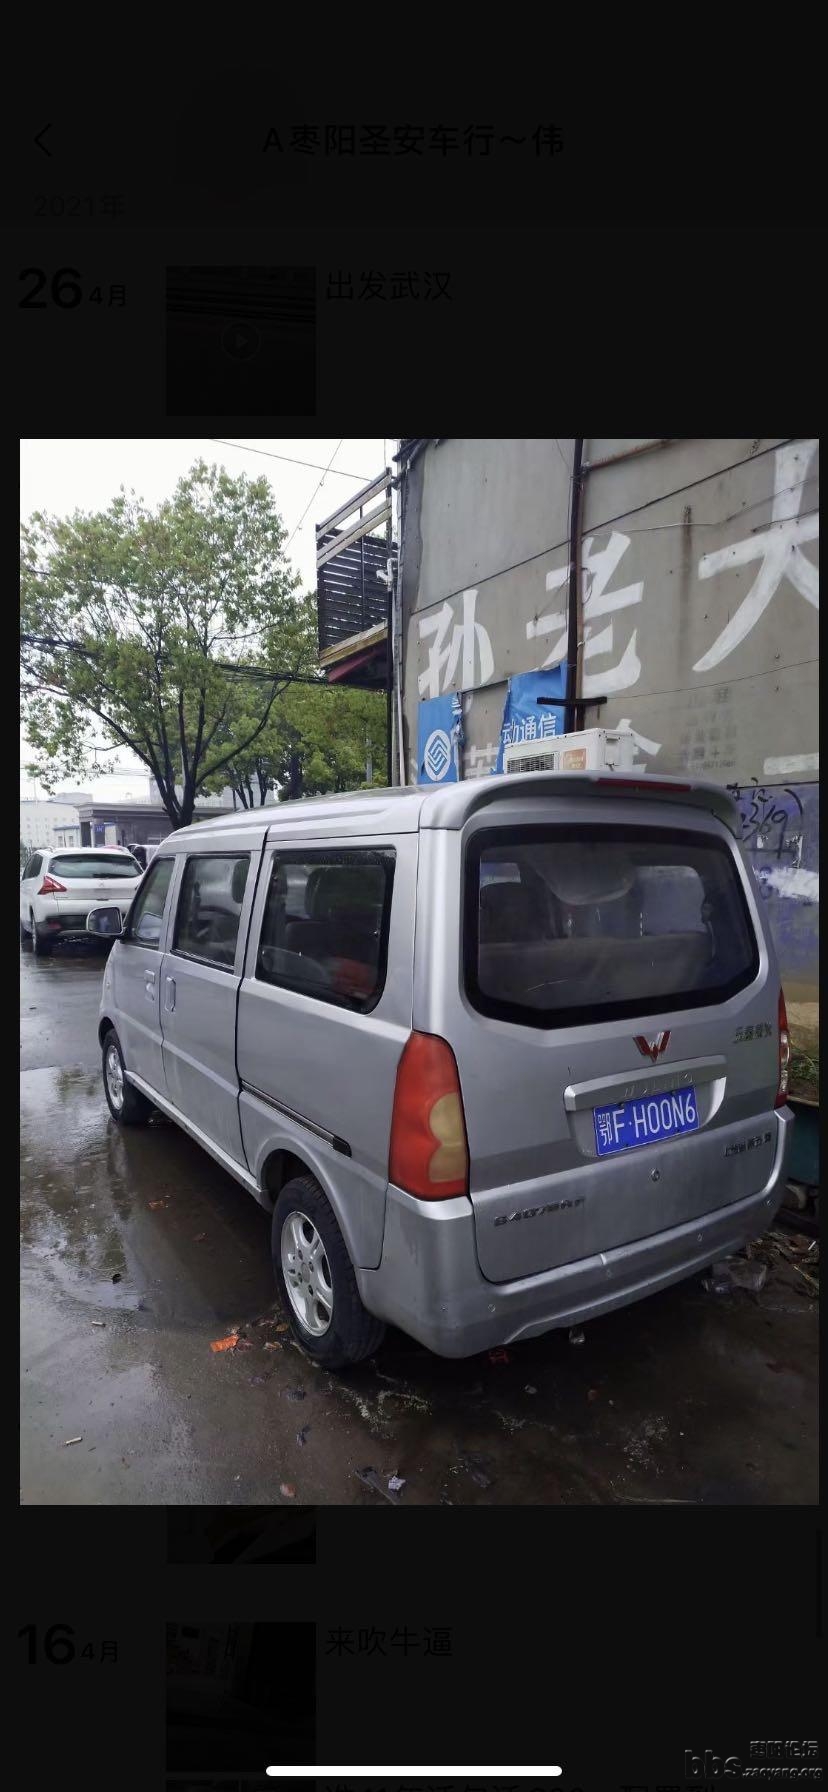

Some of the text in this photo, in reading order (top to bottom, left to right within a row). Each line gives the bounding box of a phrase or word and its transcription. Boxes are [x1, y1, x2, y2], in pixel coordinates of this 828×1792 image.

[325, 270, 454, 302] 出发武汉
[325, 1626, 454, 1658] 来吹牛逼
